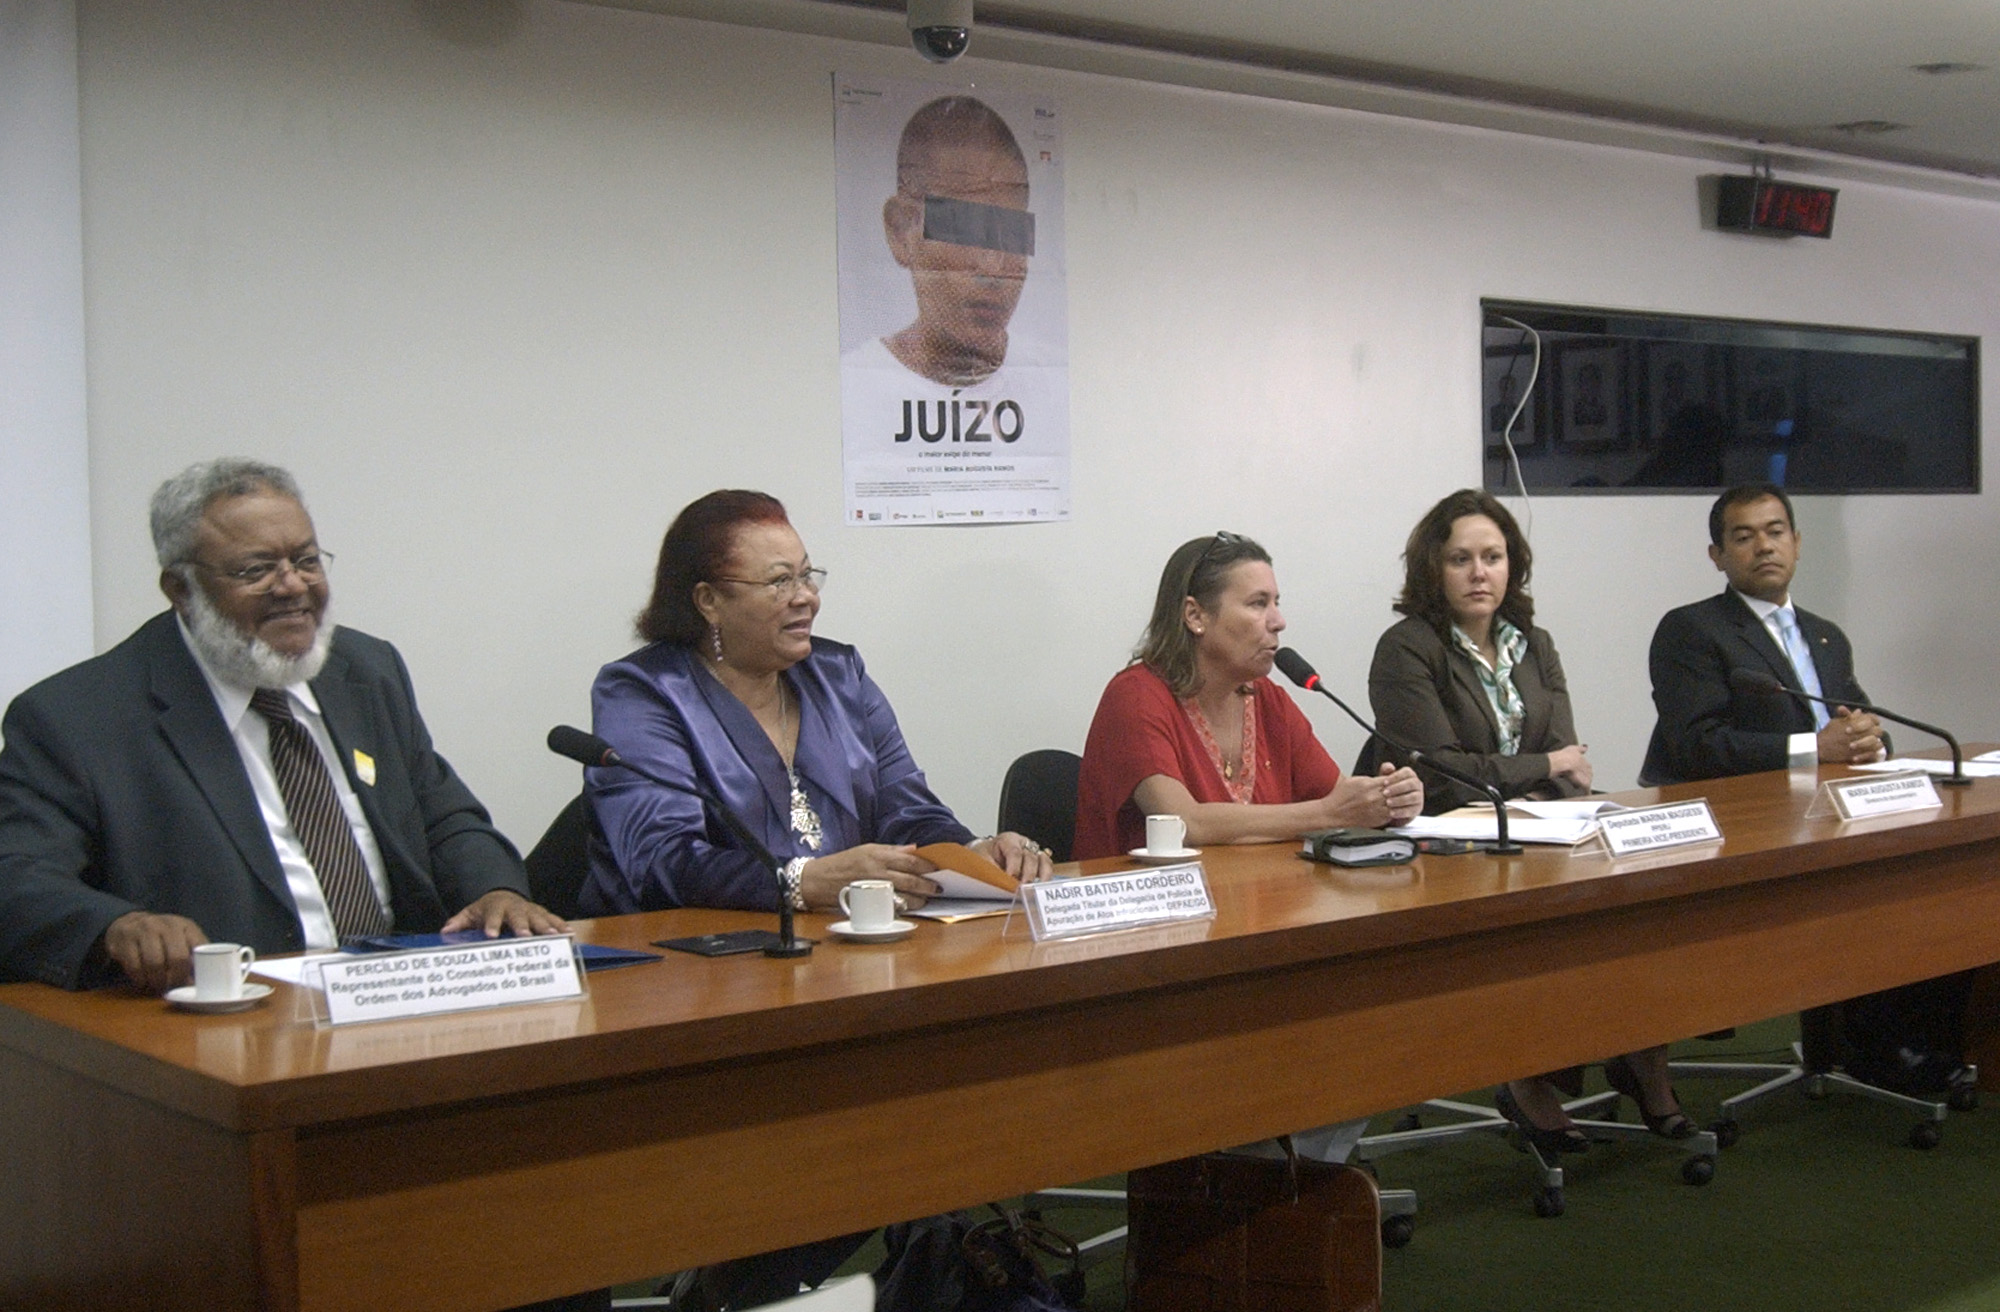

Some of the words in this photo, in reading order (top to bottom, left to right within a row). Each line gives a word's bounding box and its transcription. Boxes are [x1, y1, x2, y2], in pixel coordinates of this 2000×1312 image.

[895, 389, 1025, 443] JUÍZO
[924, 450, 943, 458] maior
[1044, 901, 1081, 914] Delegada
[1109, 897, 1118, 907] da
[1119, 892, 1156, 906] Delegacia
[1157, 892, 1167, 901] de
[1193, 886, 1203, 897] de
[1045, 886, 1083, 901] NADIR
[1085, 880, 1134, 897] BATISTA
[1136, 873, 1195, 891] CORDEIRO
[1046, 912, 1084, 926] Apuração
[1085, 911, 1096, 922] de
[1097, 909, 1115, 919] Atos
[331, 973, 424, 994] Representante
[427, 970, 444, 983] do
[446, 964, 506, 980] Conselho
[508, 958, 552, 974] Federal
[555, 957, 570, 969] da
[345, 958, 409, 977] PERCÍLIO
[413, 956, 430, 970] DE
[433, 952, 478, 967] SOUZA
[482, 948, 513, 964] LIMA
[516, 944, 551, 959] NETO
[354, 991, 399, 1007] Ordem
[402, 989, 425, 1001] dos
[428, 981, 499, 1000] Advogados
[501, 977, 517, 990] do
[520, 973, 556, 987] Brasil
